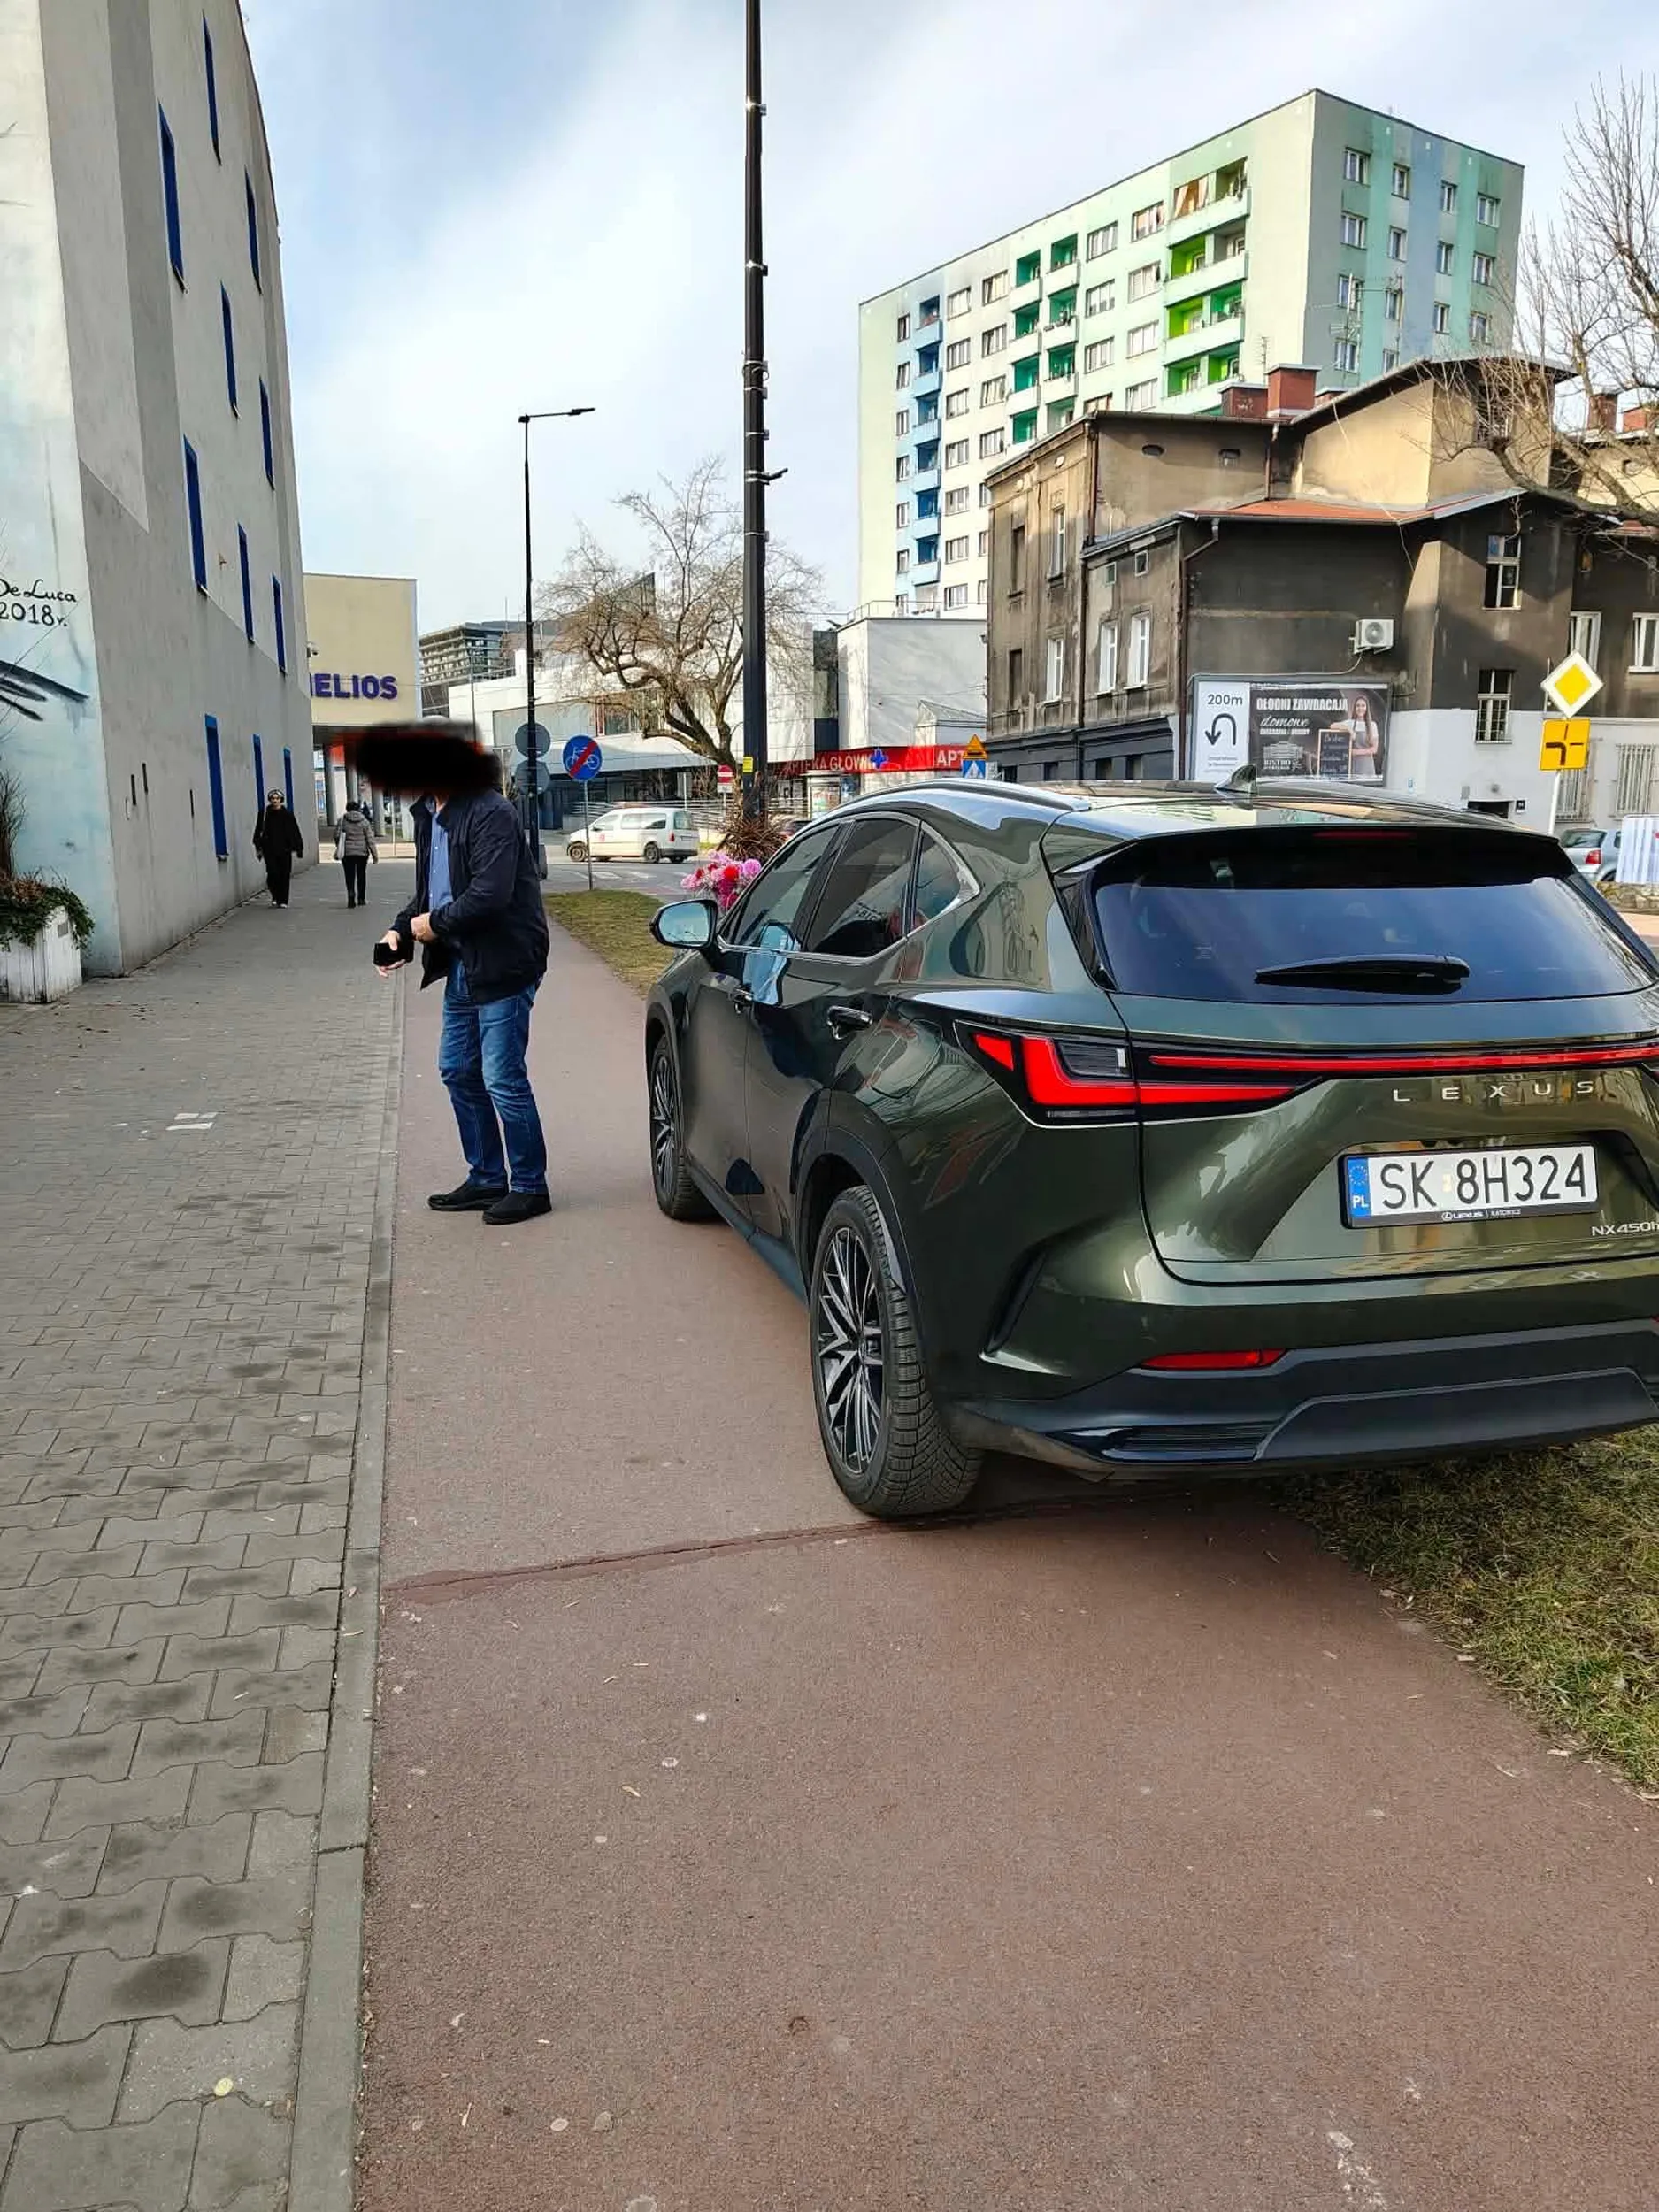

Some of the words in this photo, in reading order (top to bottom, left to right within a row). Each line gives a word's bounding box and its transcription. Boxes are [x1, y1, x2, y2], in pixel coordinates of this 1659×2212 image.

[23, 579, 77, 603] Luca
[310, 673, 397, 700] ELIOS
[1207, 694, 1243, 705] 200m
[1392, 1080, 1594, 1102] LEXUS
[1380, 1160, 1438, 1210] SK
[1455, 1153, 1586, 1204] 8H324
[1352, 1194, 1369, 1209] PL
